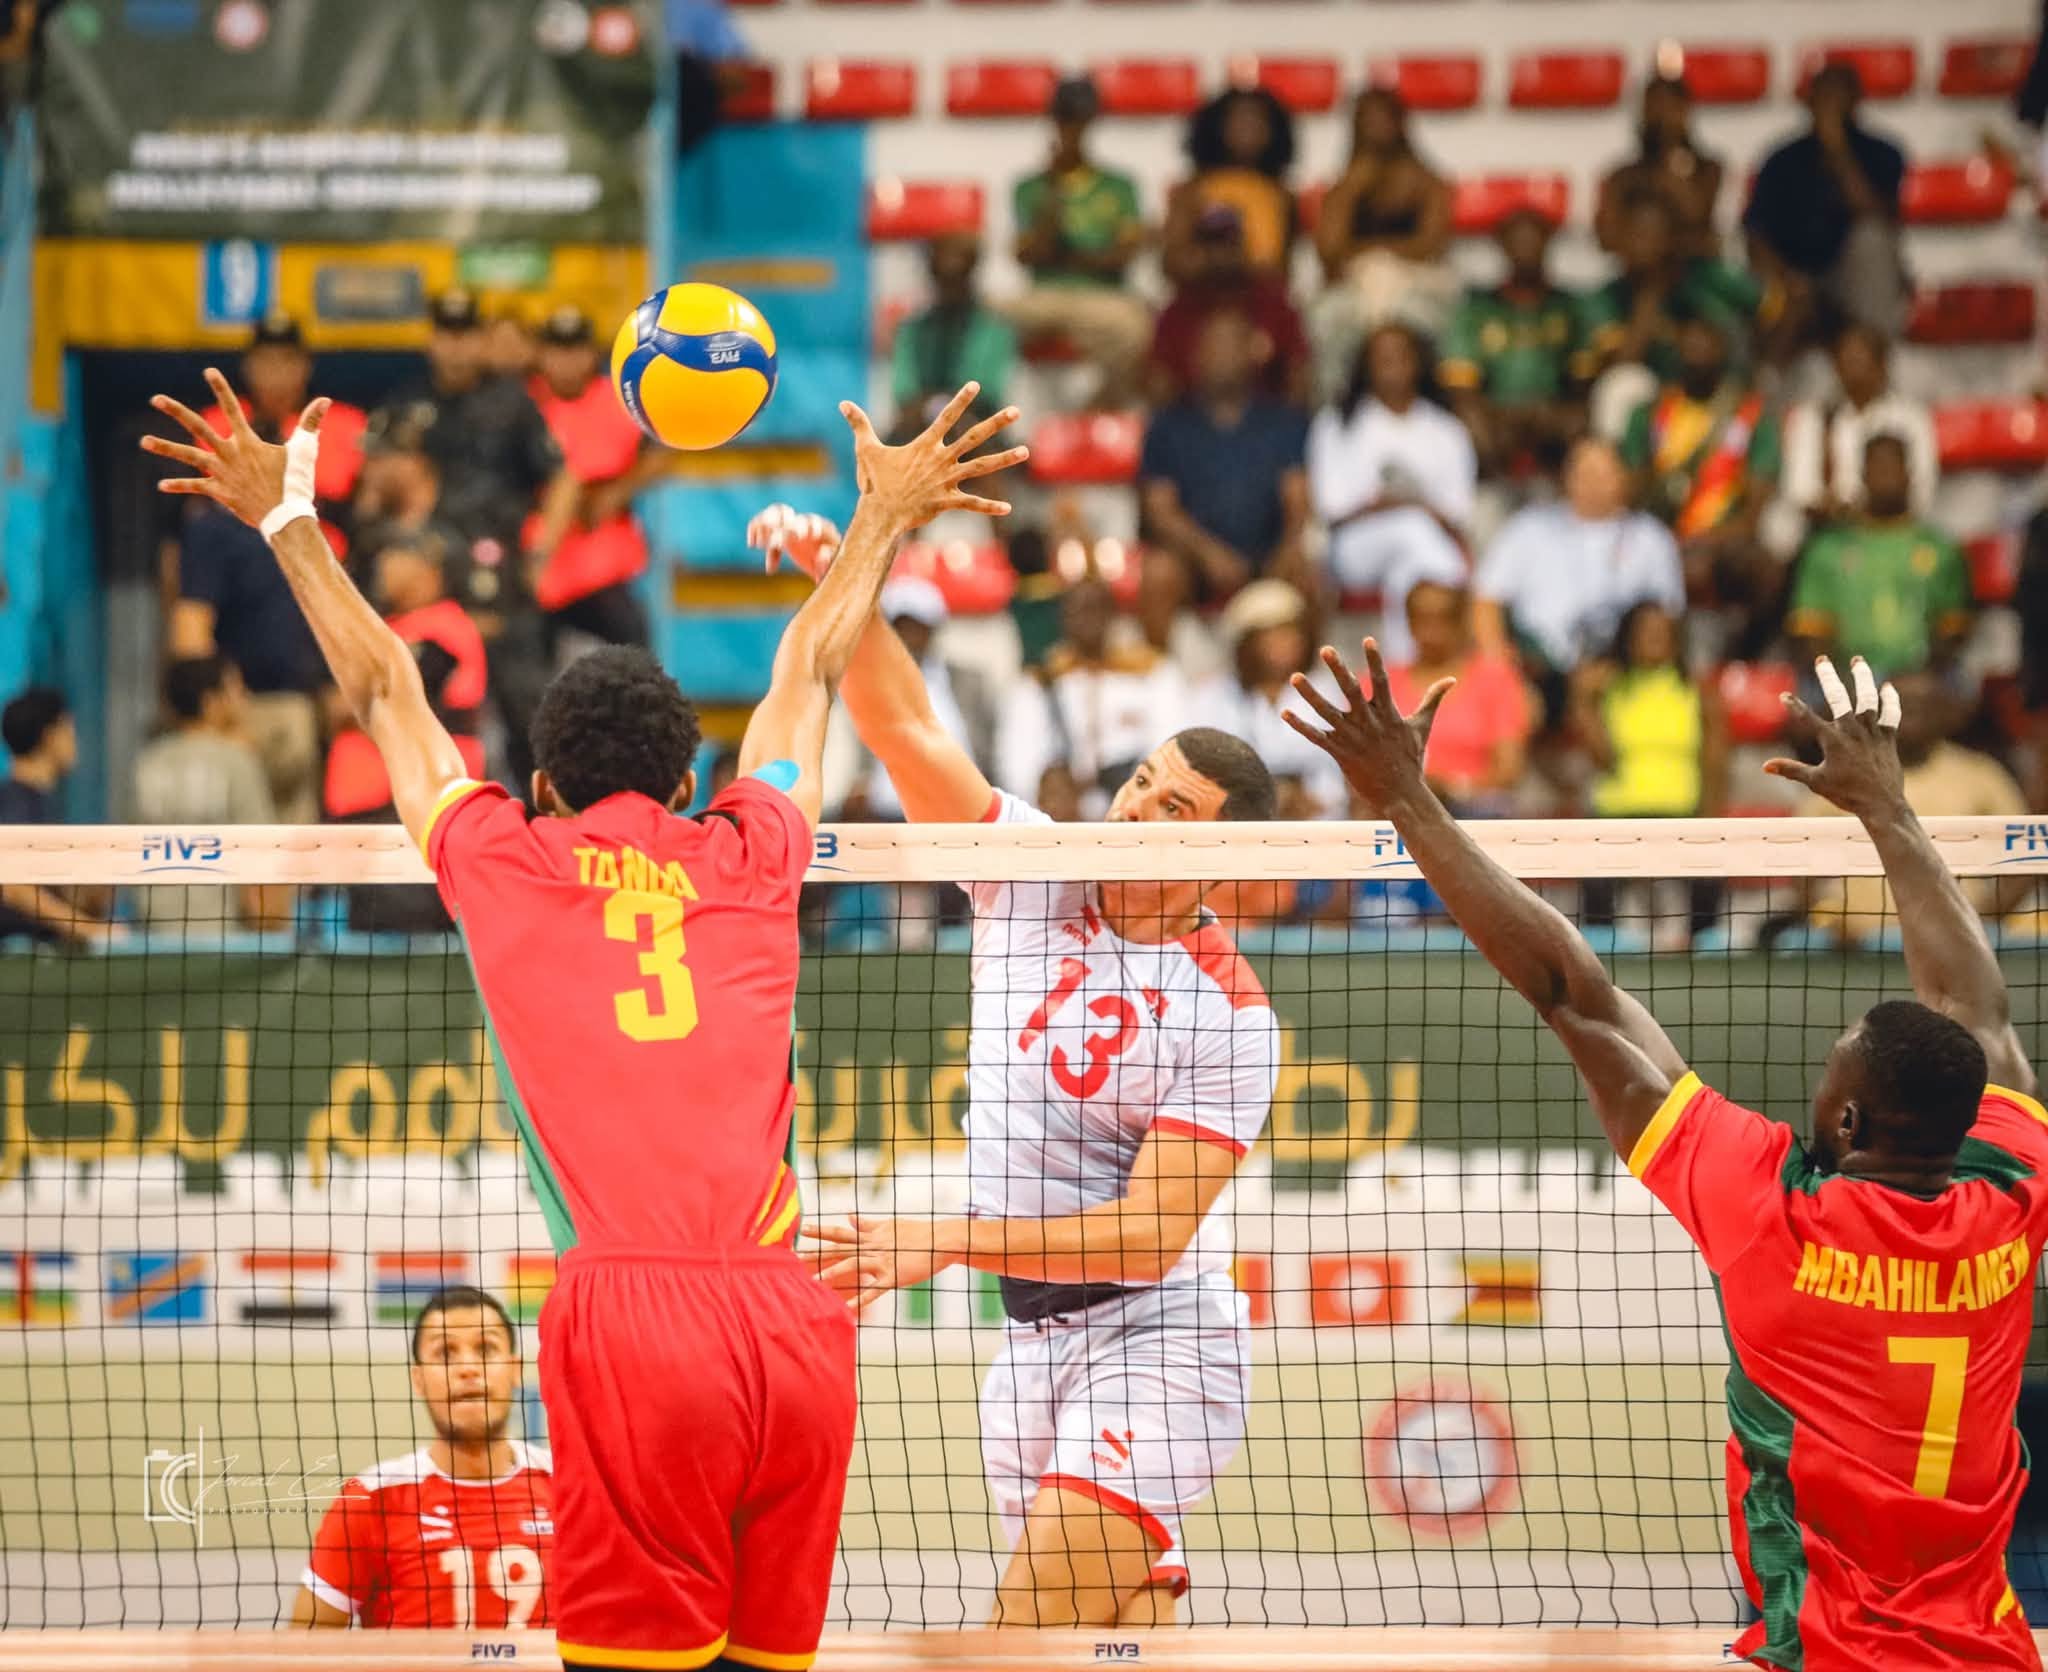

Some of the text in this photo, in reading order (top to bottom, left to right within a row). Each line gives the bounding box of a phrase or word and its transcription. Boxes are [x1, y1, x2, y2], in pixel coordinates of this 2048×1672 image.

[142, 834, 222, 861] FIVB
[604, 889, 698, 1042] 3
[1018, 957, 1140, 1099] 13
[1793, 1232, 2030, 1312] MBAHILAMEN
[1887, 1336, 1970, 1500] 7
[438, 1544, 544, 1629] 19
[471, 1643, 517, 1659] FIVB
[1095, 1643, 1140, 1658] FIVB
